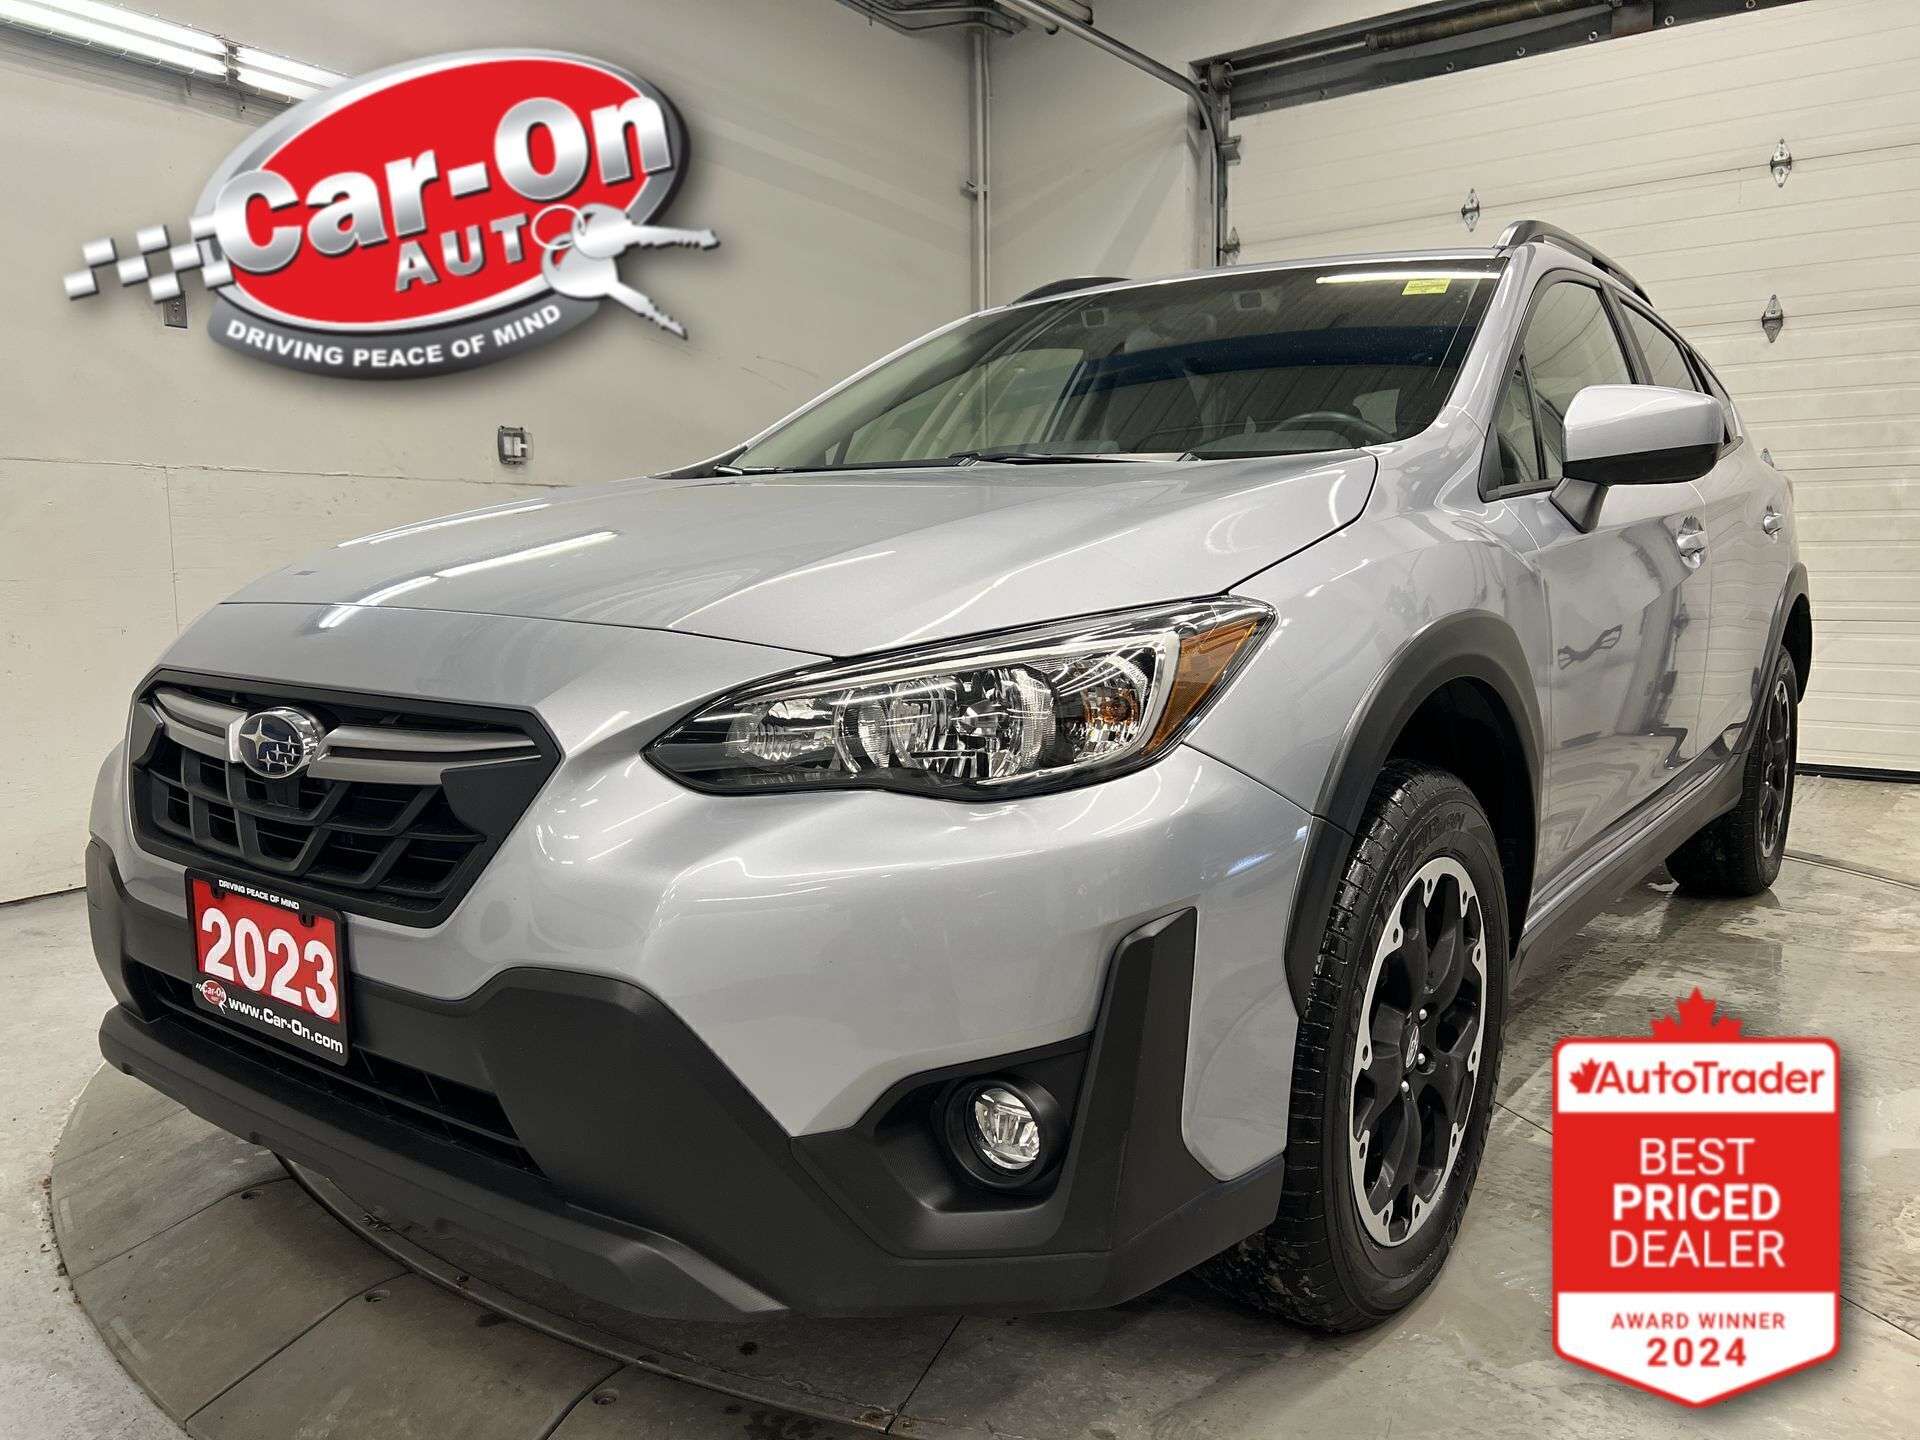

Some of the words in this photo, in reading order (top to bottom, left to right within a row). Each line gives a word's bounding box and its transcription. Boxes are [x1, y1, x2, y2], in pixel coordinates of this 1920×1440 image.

[218, 879, 245, 894] DRIVING
[246, 887, 269, 901] PEACE
[269, 894, 280, 903] OF
[280, 898, 300, 910] MIND
[201, 907, 338, 1019] 2023
[228, 997, 344, 1054] www.Car-On.com
